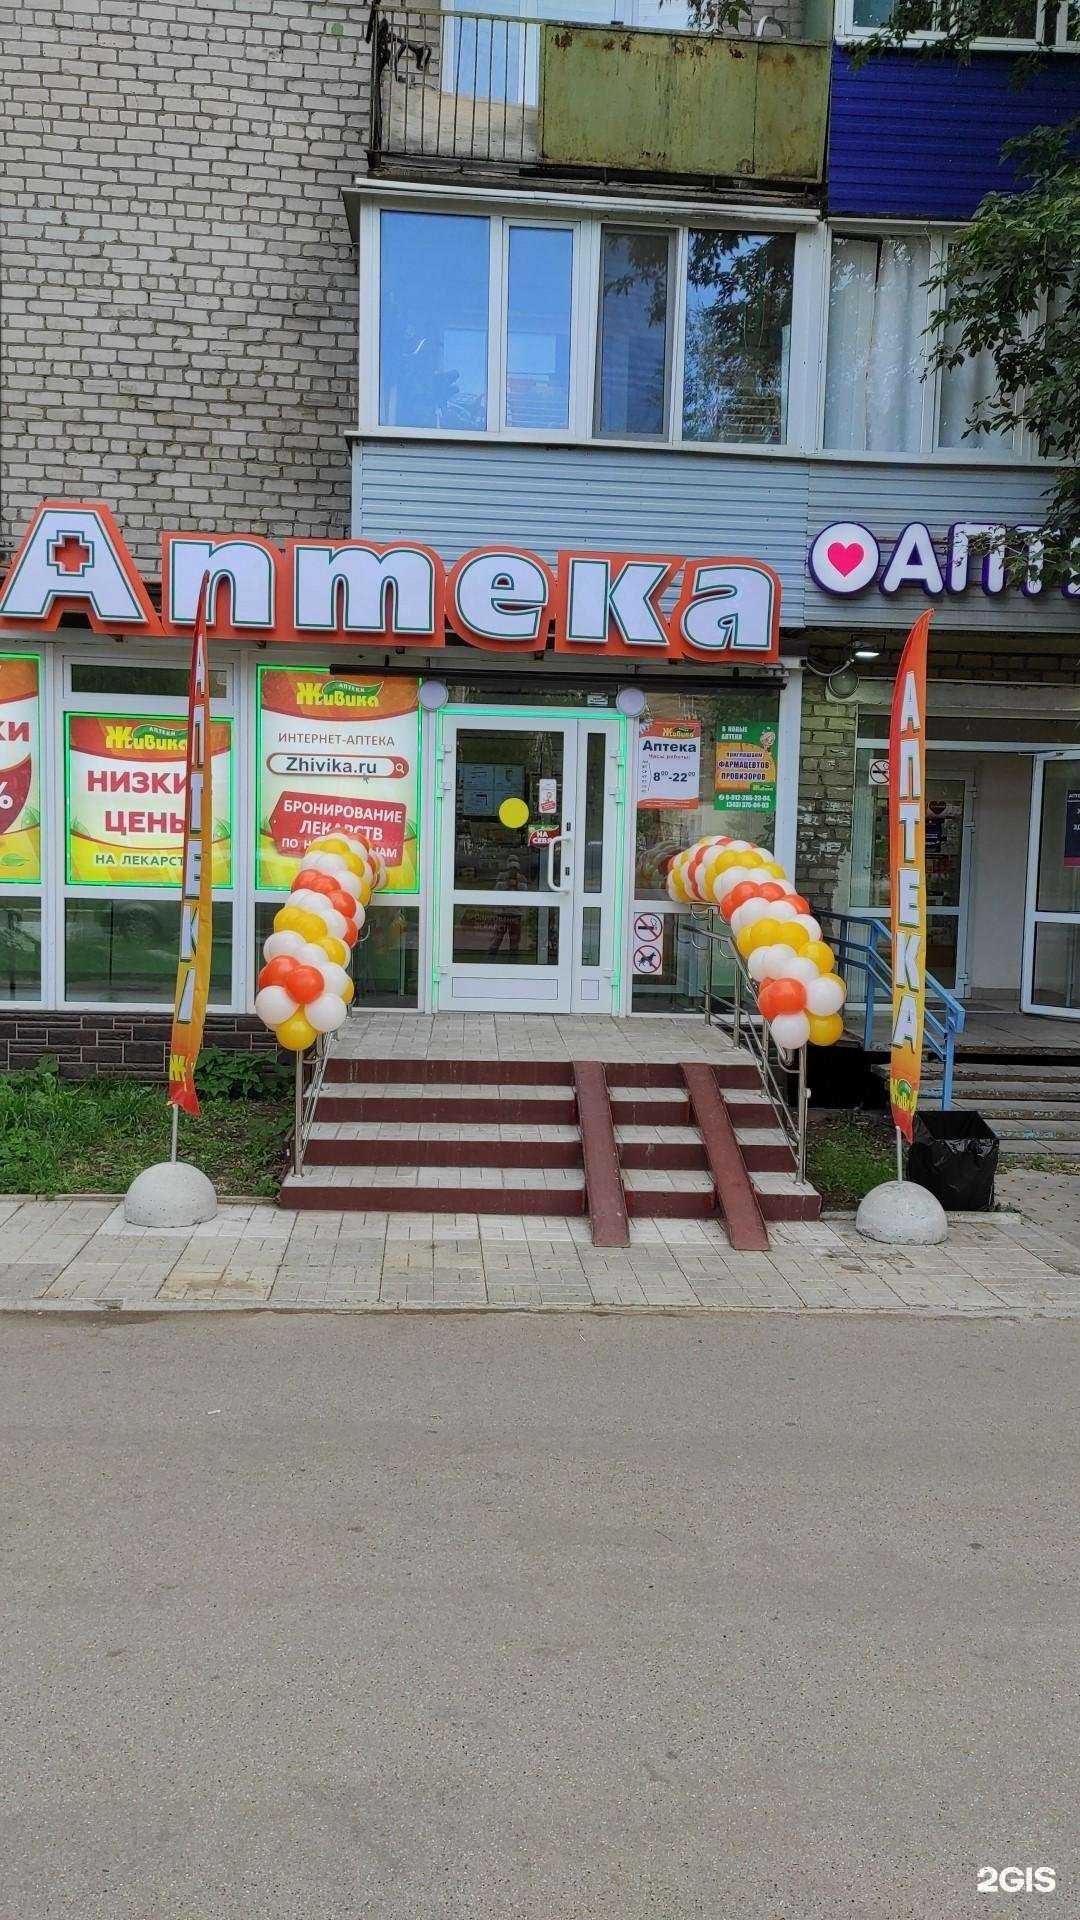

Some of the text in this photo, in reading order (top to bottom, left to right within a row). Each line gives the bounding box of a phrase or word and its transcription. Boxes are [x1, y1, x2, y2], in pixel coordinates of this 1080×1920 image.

[879, 521, 1080, 597] АПТ
[0, 508, 775, 652] Аптека
[297, 682, 380, 707] Живика
[278, 732, 395, 747] ИНТЕРНЕТ-АПТЕКА
[642, 740, 697, 753] Аптека
[286, 756, 377, 774] Zhivika.ru
[718, 760, 770, 769] ФАРМАЦЕВТОВ
[87, 770, 187, 795] НИЗКИ
[721, 772, 766, 781] ПРОВИЗОРОВ
[284, 799, 403, 823] БРОНИРОВАНИЕ
[281, 837, 299, 849] ПО
[95, 854, 184, 866] НА ЛЕКАРСТ
[892, 670, 921, 1049] АПТЕКА
